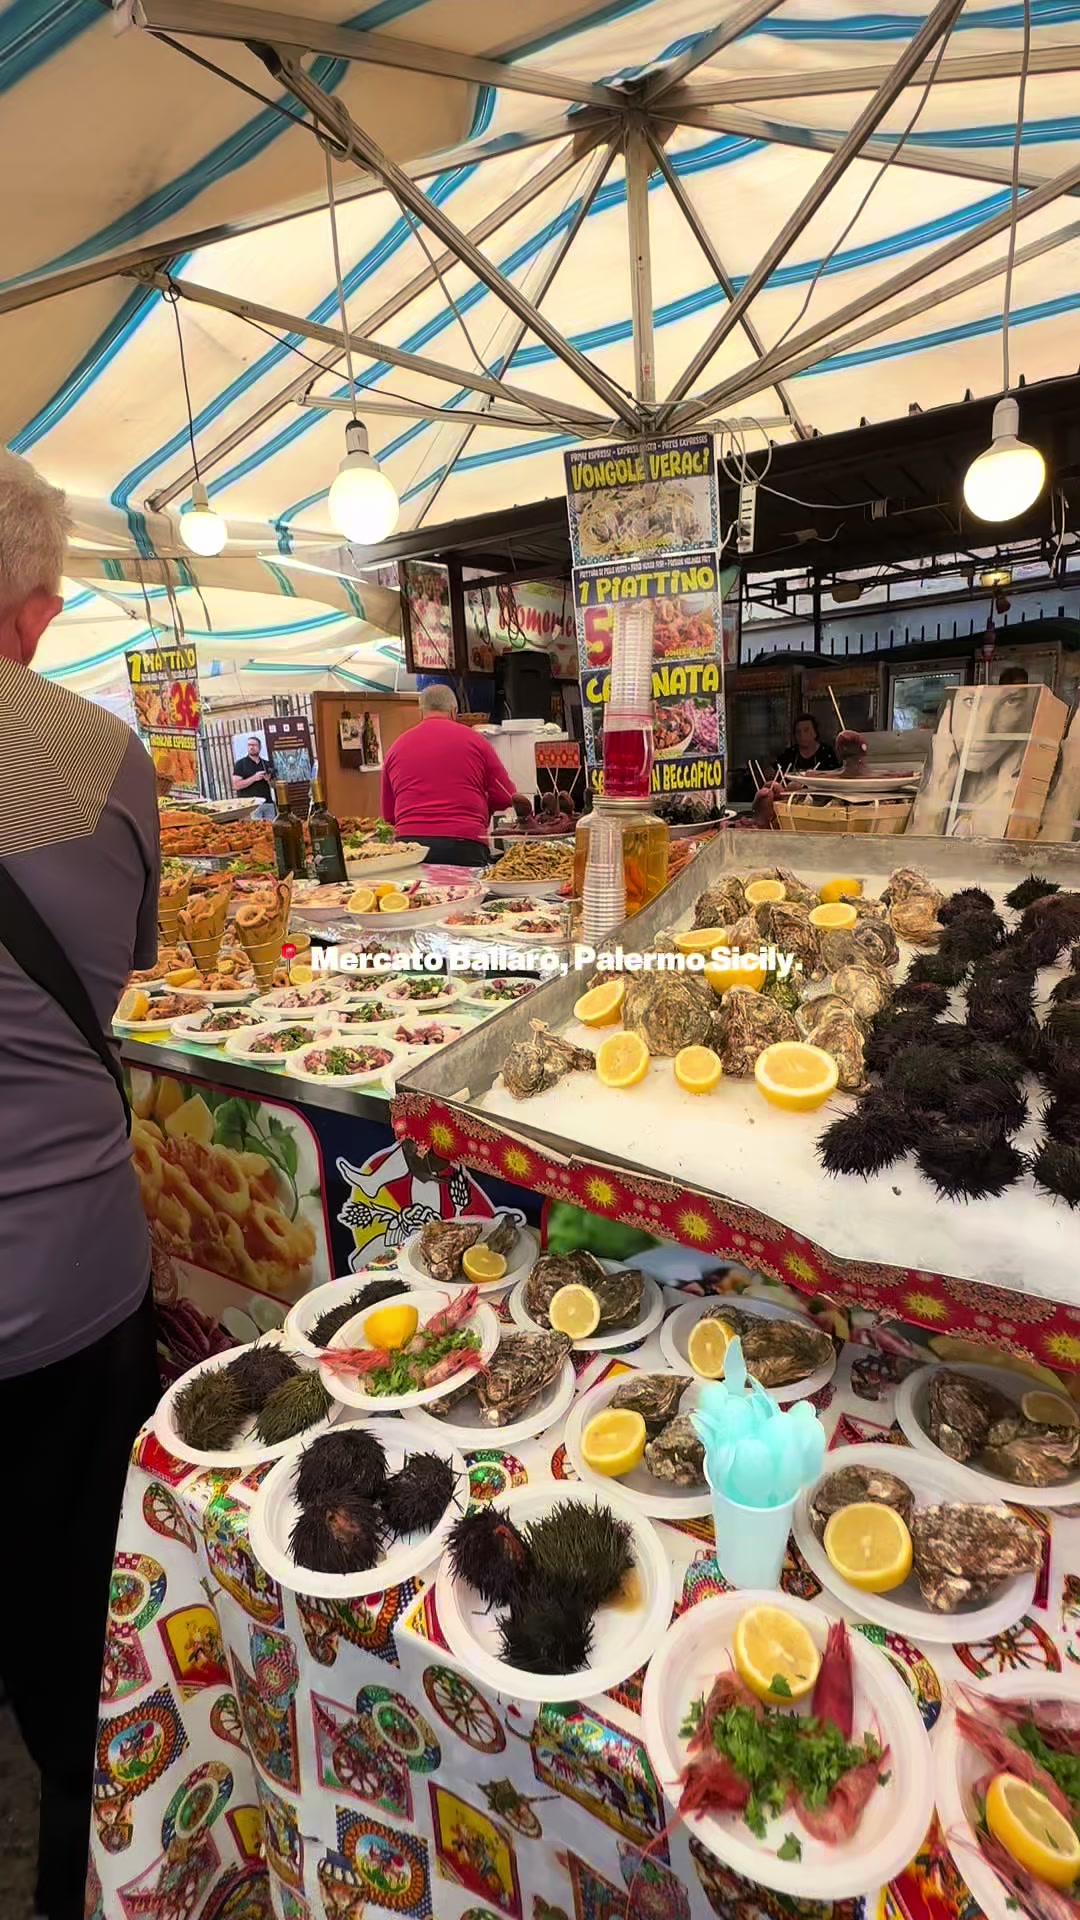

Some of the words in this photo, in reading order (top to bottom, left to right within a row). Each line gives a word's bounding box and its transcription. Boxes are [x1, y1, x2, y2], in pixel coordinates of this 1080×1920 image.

[571, 458, 645, 491] VONGOLE
[578, 581, 590, 604] 1
[128, 653, 141, 682] 1
[586, 664, 719, 704] CANATA
[663, 760, 722, 791] BECCAFICO
